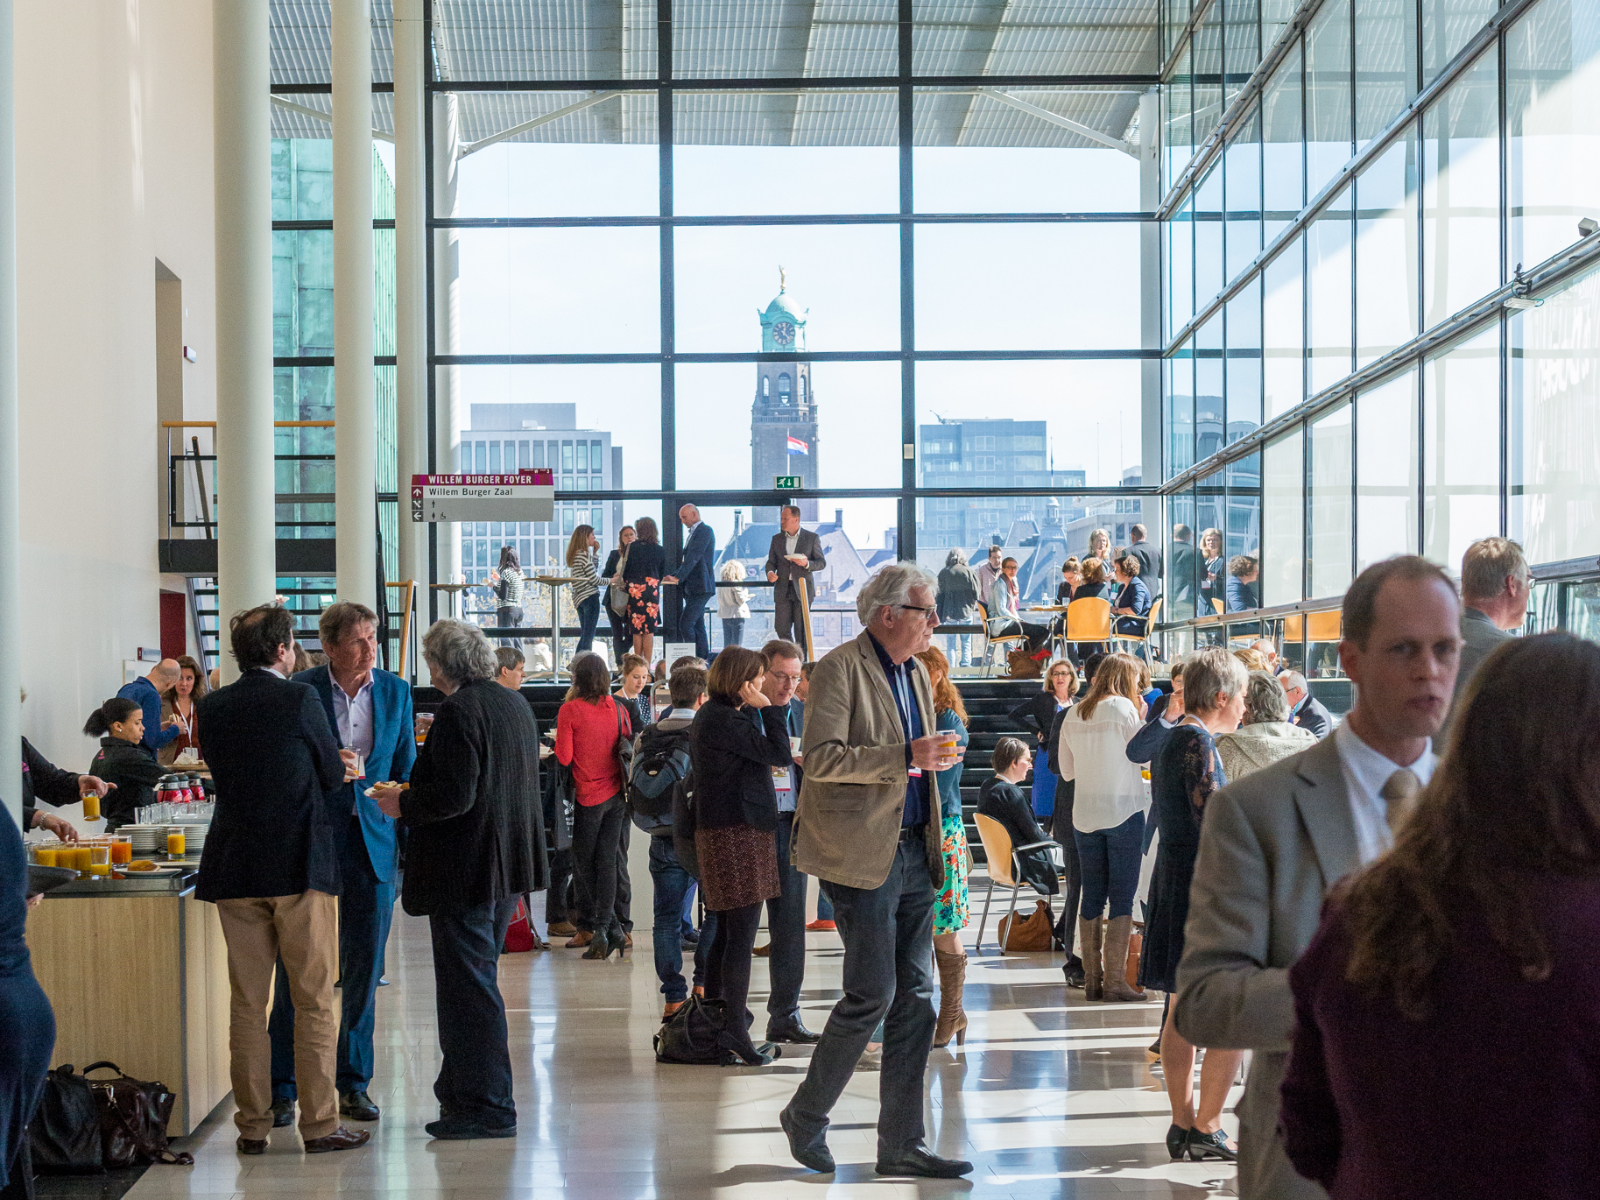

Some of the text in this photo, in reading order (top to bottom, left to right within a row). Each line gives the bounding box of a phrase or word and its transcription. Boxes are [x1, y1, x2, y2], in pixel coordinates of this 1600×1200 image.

[428, 475, 532, 484] WILLEM BURGER FOYER
[429, 488, 513, 498] Willem Burger Zaal
